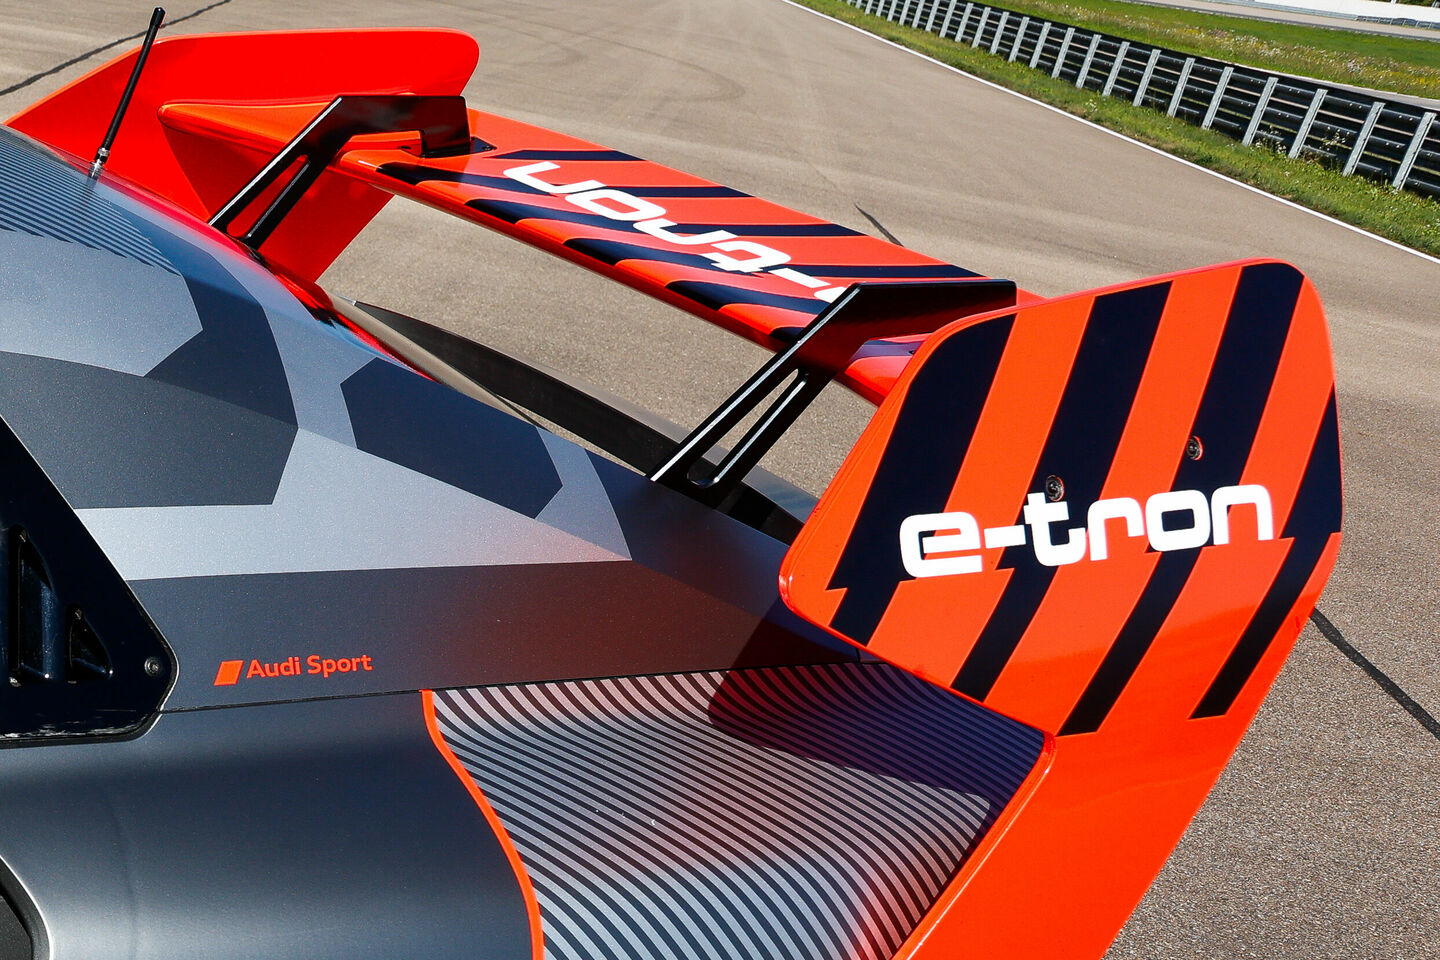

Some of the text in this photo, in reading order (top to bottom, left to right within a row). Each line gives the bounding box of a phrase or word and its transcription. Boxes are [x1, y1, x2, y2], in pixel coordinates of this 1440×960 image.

[899, 484, 1274, 579] e-tron
[246, 654, 374, 680] Audi Sport
